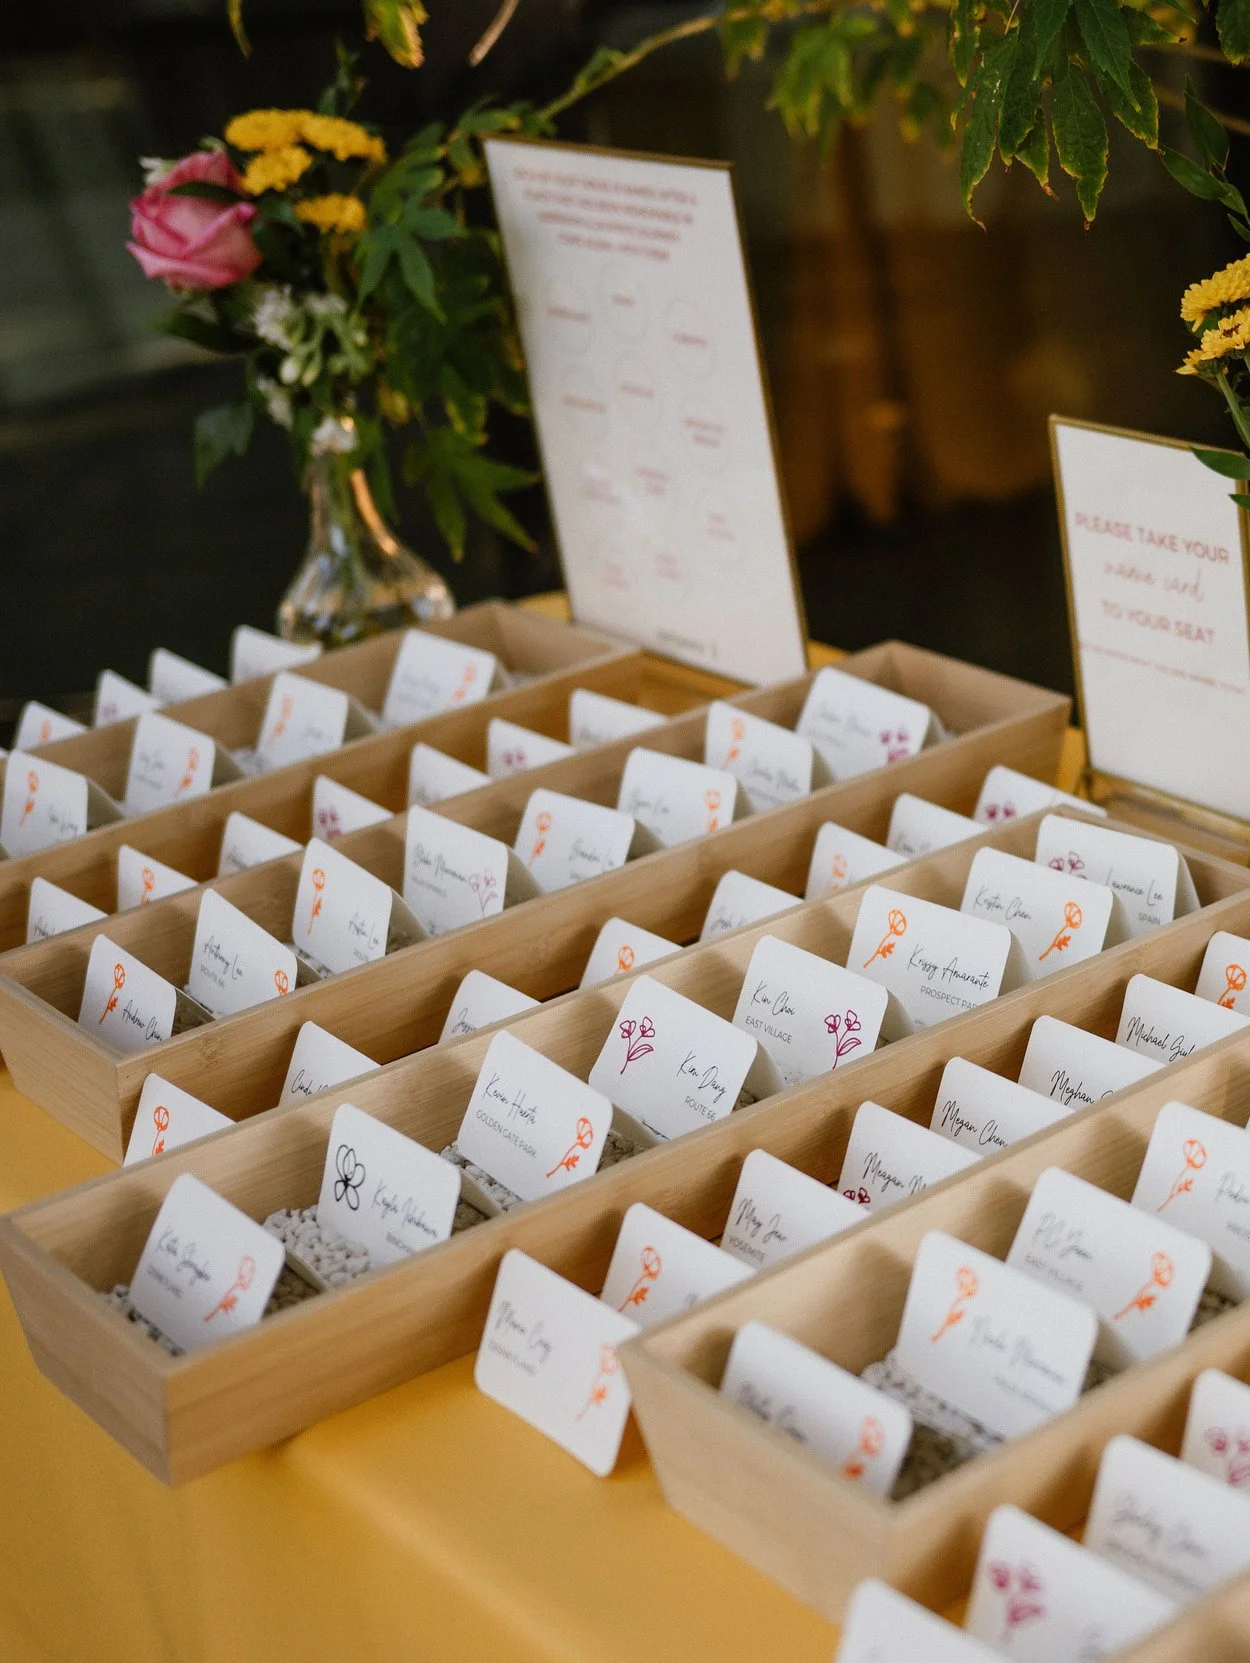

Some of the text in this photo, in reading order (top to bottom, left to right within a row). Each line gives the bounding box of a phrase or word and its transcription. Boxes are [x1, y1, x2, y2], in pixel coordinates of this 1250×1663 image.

[1074, 511, 1230, 565] PLEASE TAKE YOUR
[1102, 600, 1216, 645] TO YOUR SEAT
[941, 957, 990, 991] Amarante
[920, 985, 978, 1010] PROSPECT PAR
[745, 1016, 793, 1045] EAST VILLAGE
[1127, 1016, 1168, 1050] Michael
[698, 1065, 727, 1103] Dang
[1051, 1071, 1094, 1106] Meghan
[685, 1095, 716, 1121] ROUTE 66
[942, 1100, 1008, 1150] Megan Chen
[477, 1110, 537, 1159] GOLDEN GATE PARK
[863, 1152, 906, 1193] Meagan
